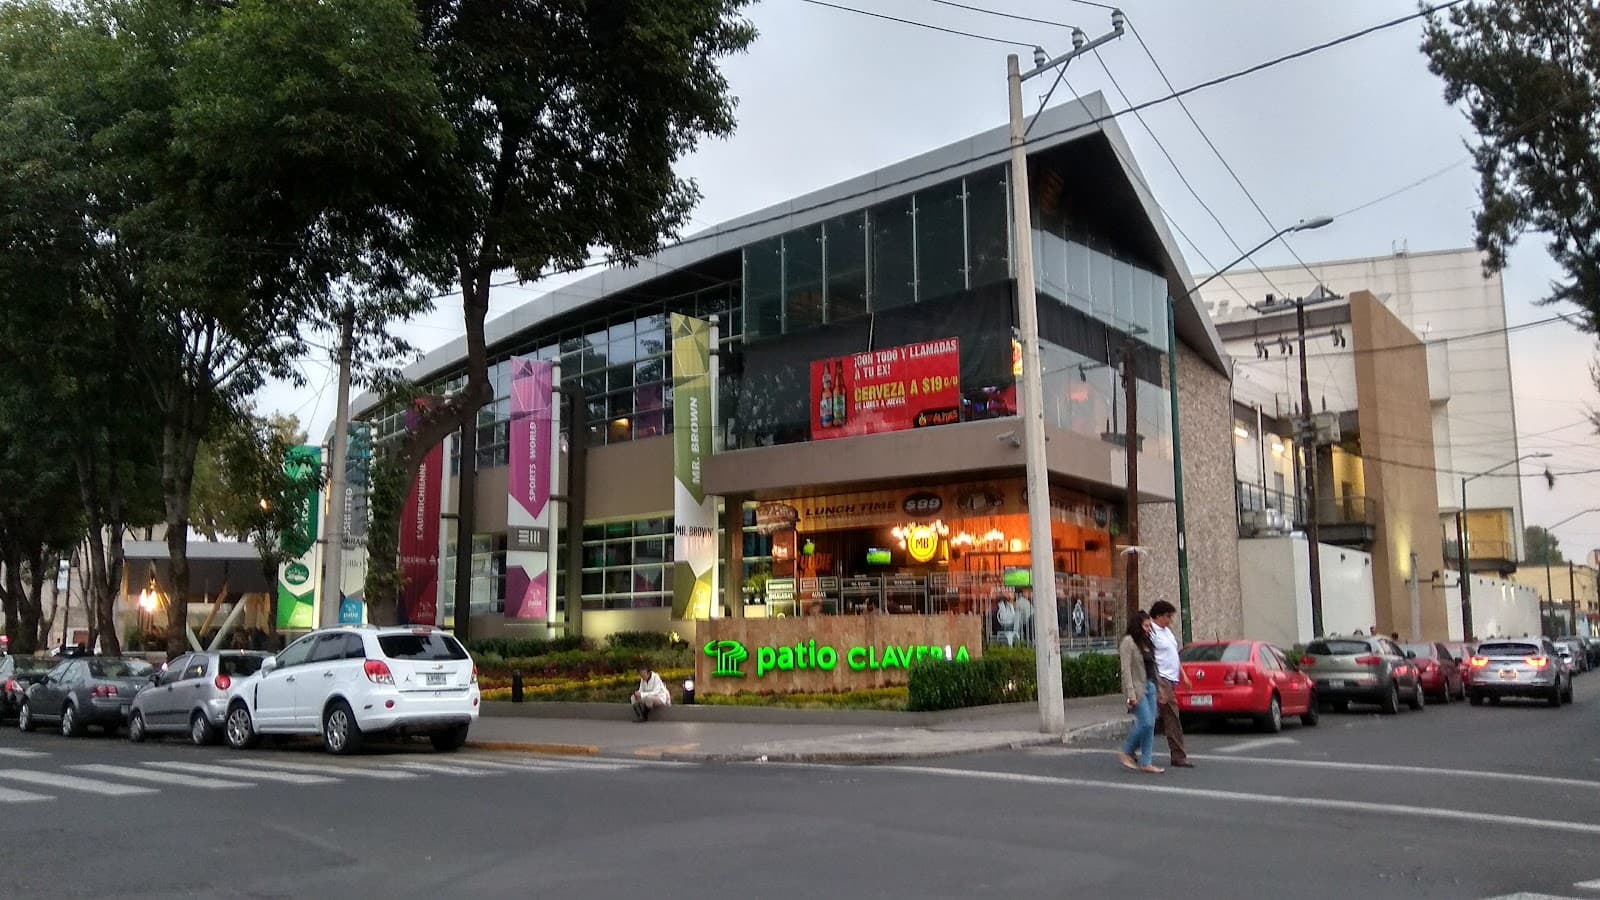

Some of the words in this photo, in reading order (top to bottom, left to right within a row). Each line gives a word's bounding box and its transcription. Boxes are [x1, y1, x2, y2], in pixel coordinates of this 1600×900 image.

[876, 350, 898, 364] TODO
[901, 348, 907, 361] Y
[909, 339, 957, 358] LLAMADAS
[854, 371, 861, 382] A
[863, 366, 874, 379] TU
[876, 363, 891, 376] EX!
[854, 381, 905, 403] CERVEZA
[910, 380, 918, 396] A
[922, 377, 943, 395] $19
[862, 400, 880, 409] LUNES
[885, 397, 906, 408] JUEVES
[691, 396, 699, 452] BROWN
[529, 421, 537, 459] WORLD
[692, 456, 701, 484] MR.
[529, 463, 537, 503] SPORTS
[805, 504, 856, 517] LUNCH
[860, 501, 897, 513] TIME
[675, 526, 688, 537] MR.
[689, 526, 713, 538] BROWN
[915, 537, 929, 549] MB
[757, 638, 838, 679] patio
